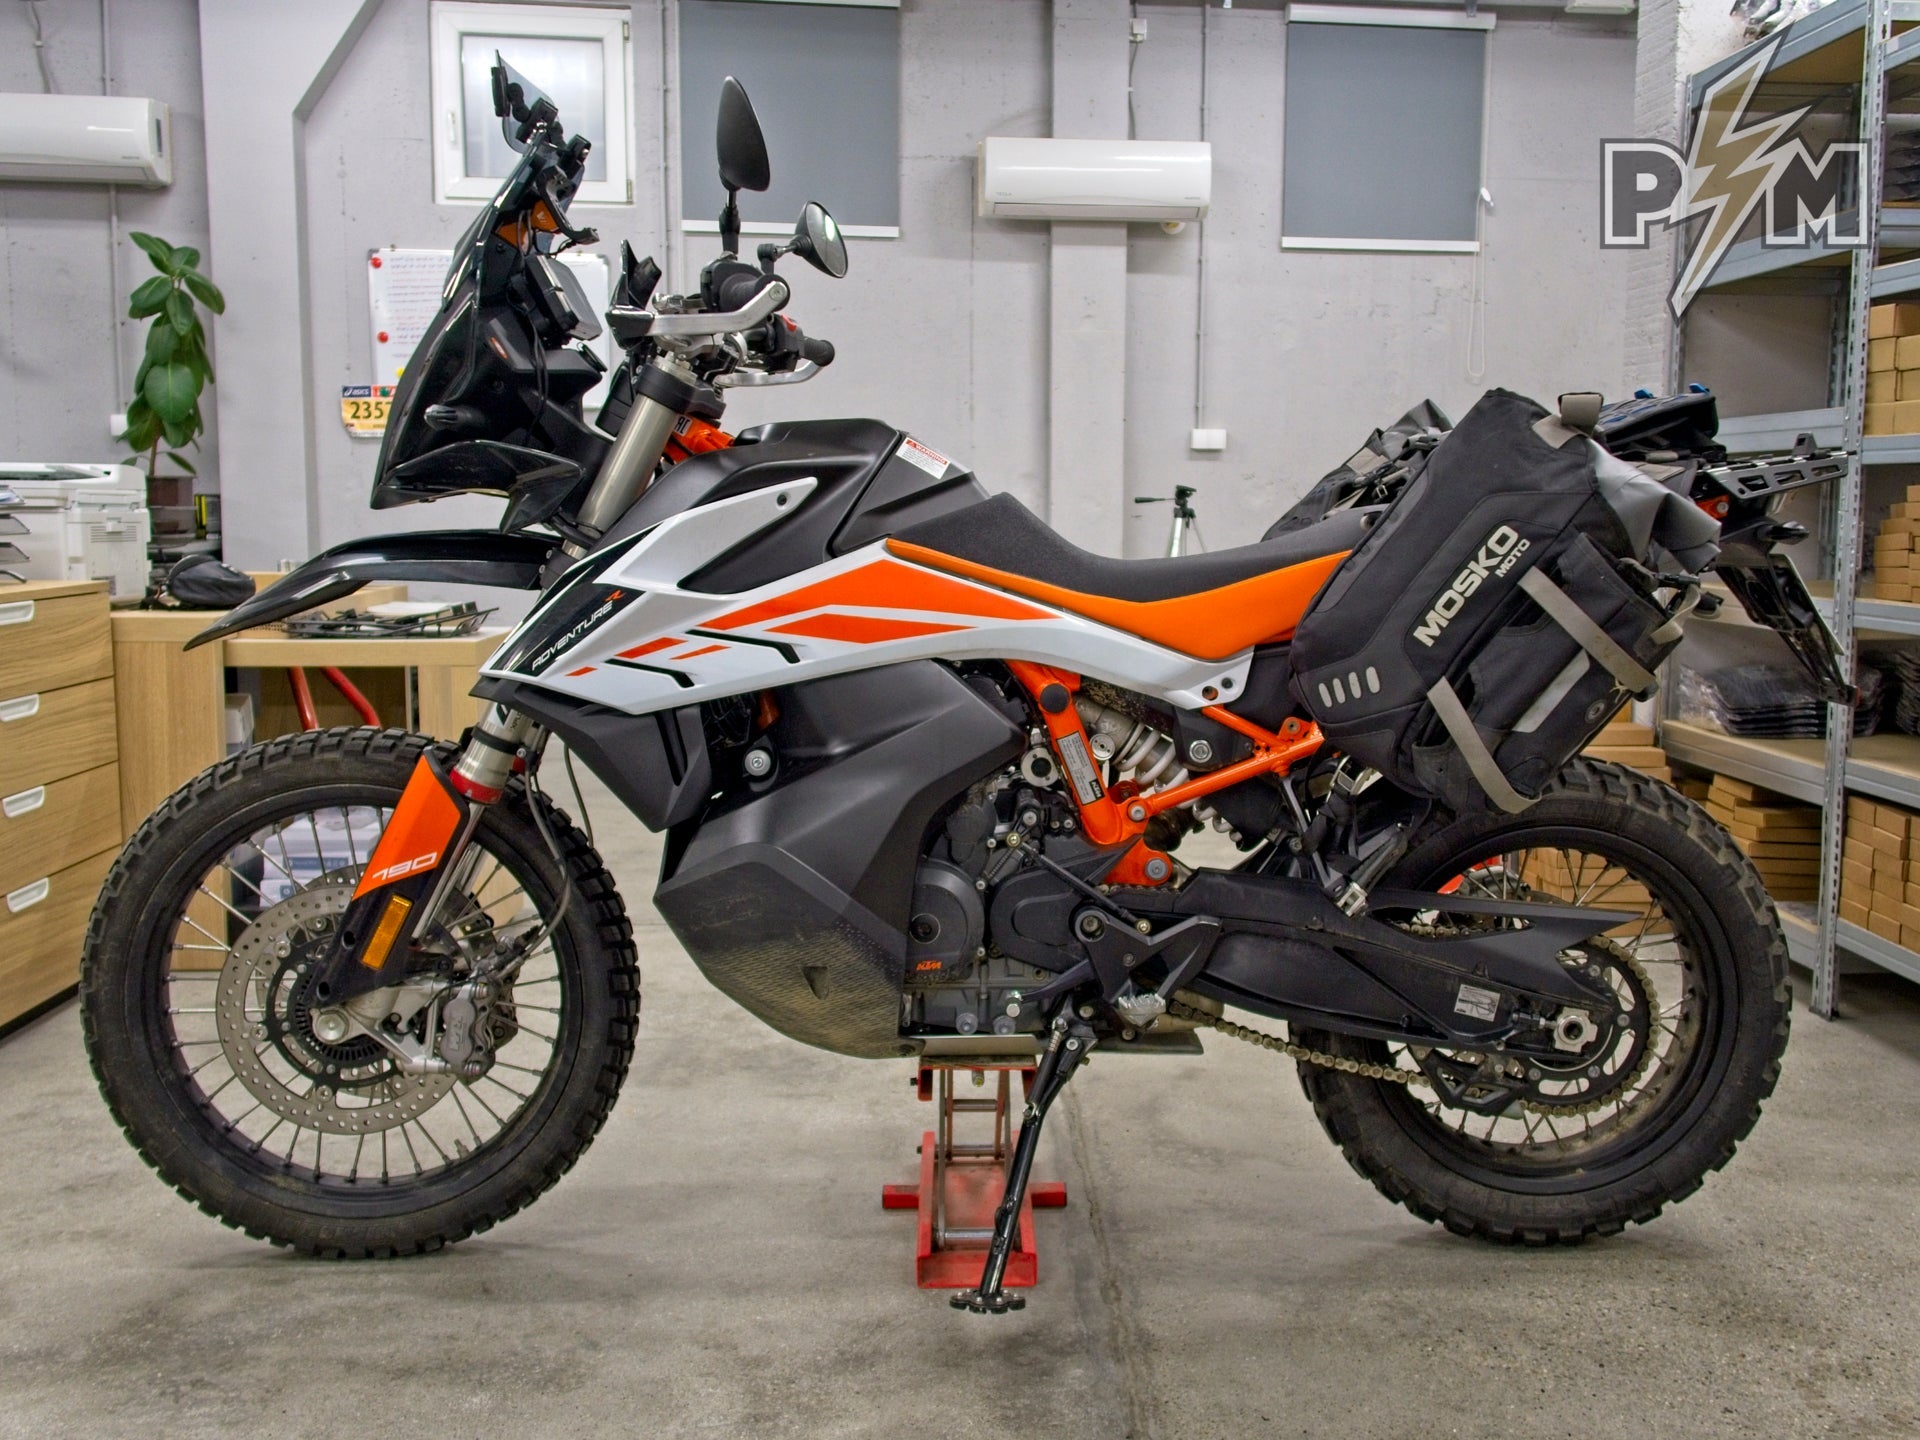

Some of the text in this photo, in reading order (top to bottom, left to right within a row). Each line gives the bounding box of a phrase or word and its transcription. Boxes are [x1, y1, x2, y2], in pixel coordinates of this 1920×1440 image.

[916, 443, 946, 465] WARNING
[1494, 538, 1531, 578] MOTO
[1413, 525, 1519, 647] MOSKO
[532, 600, 613, 671] ADVENTURE
[372, 852, 437, 880] 790
[916, 960, 942, 971] KTM
